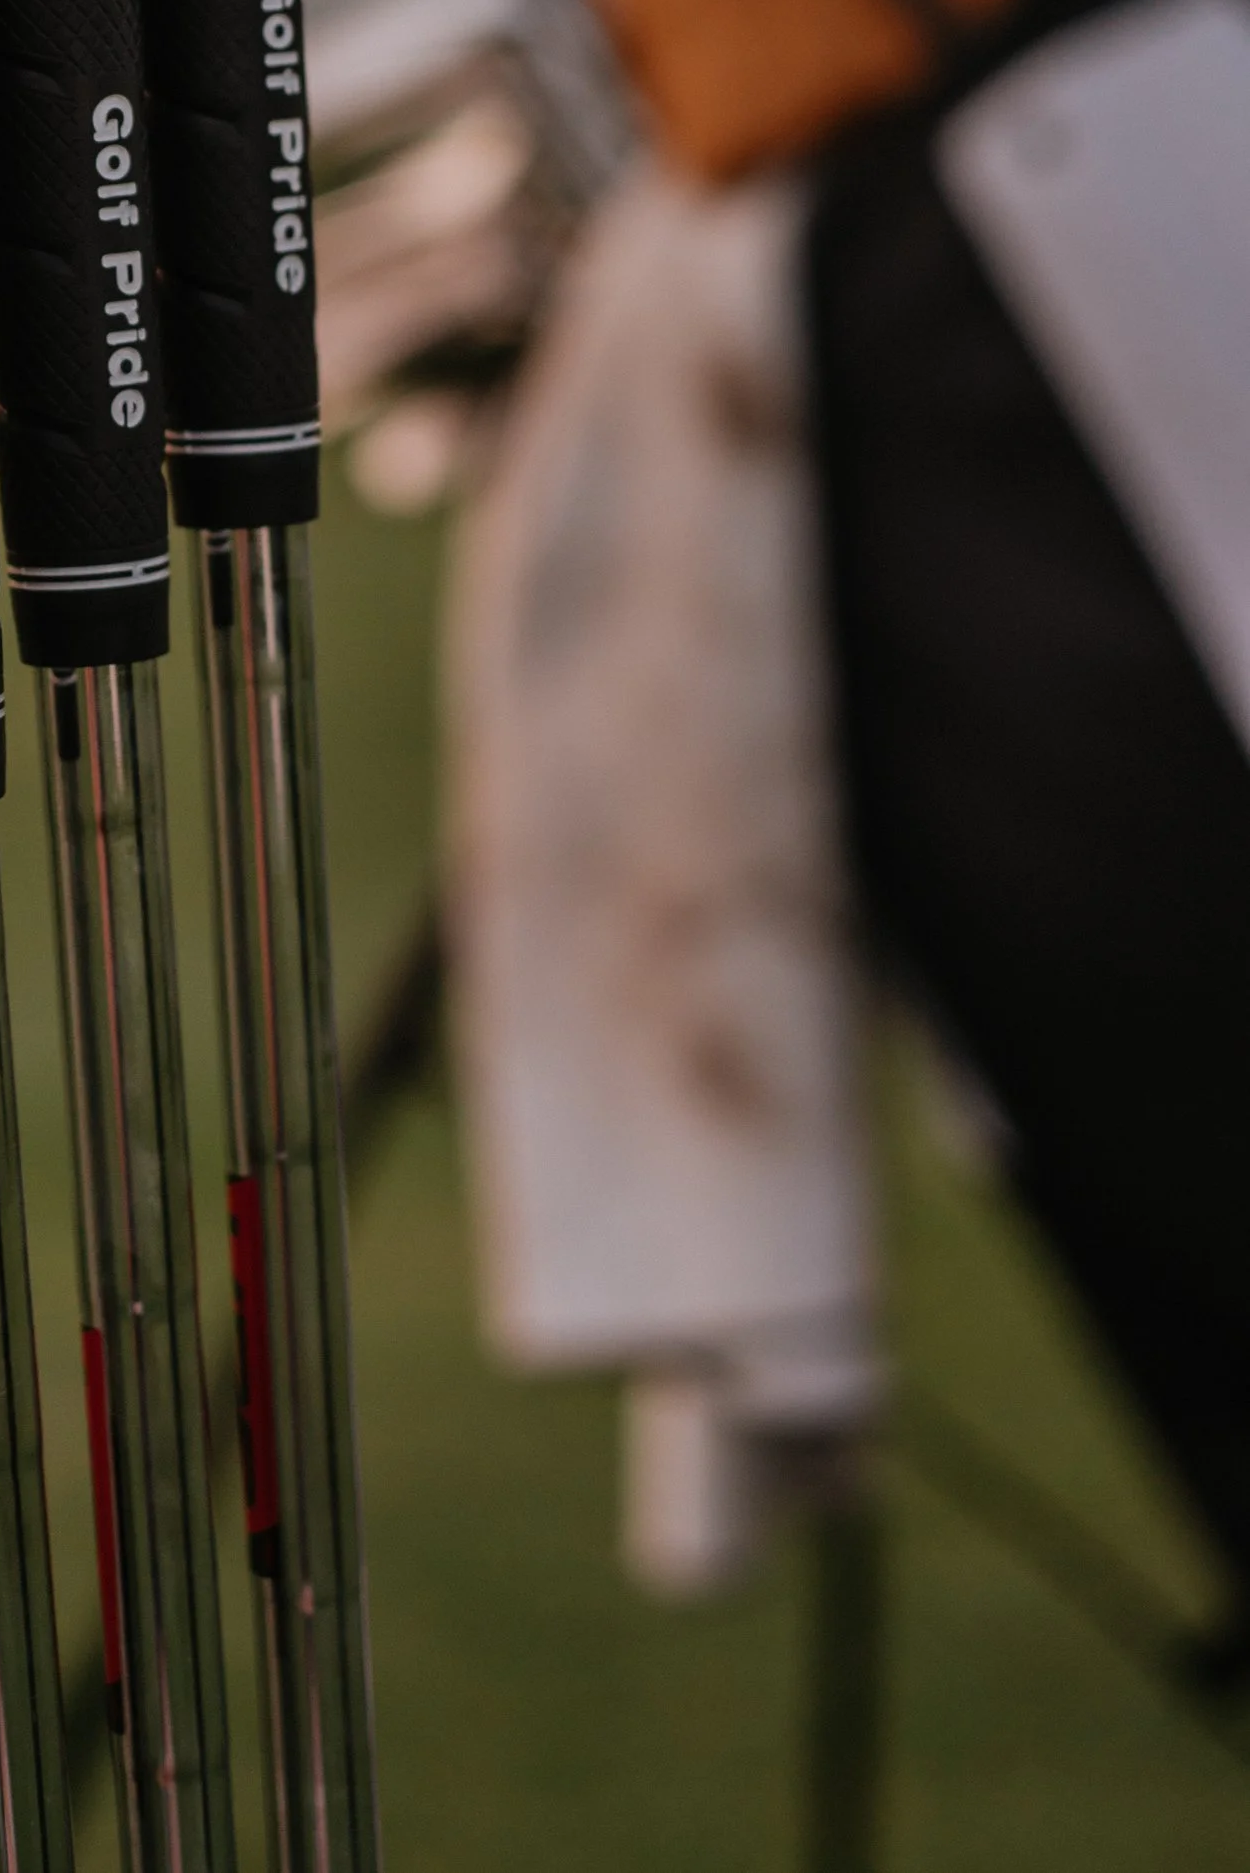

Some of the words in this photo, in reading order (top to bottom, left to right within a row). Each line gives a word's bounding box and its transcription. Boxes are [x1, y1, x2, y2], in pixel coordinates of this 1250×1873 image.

[92, 94, 140, 227] Golf
[268, 118, 308, 294] Pride
[101, 250, 149, 428] Pride
